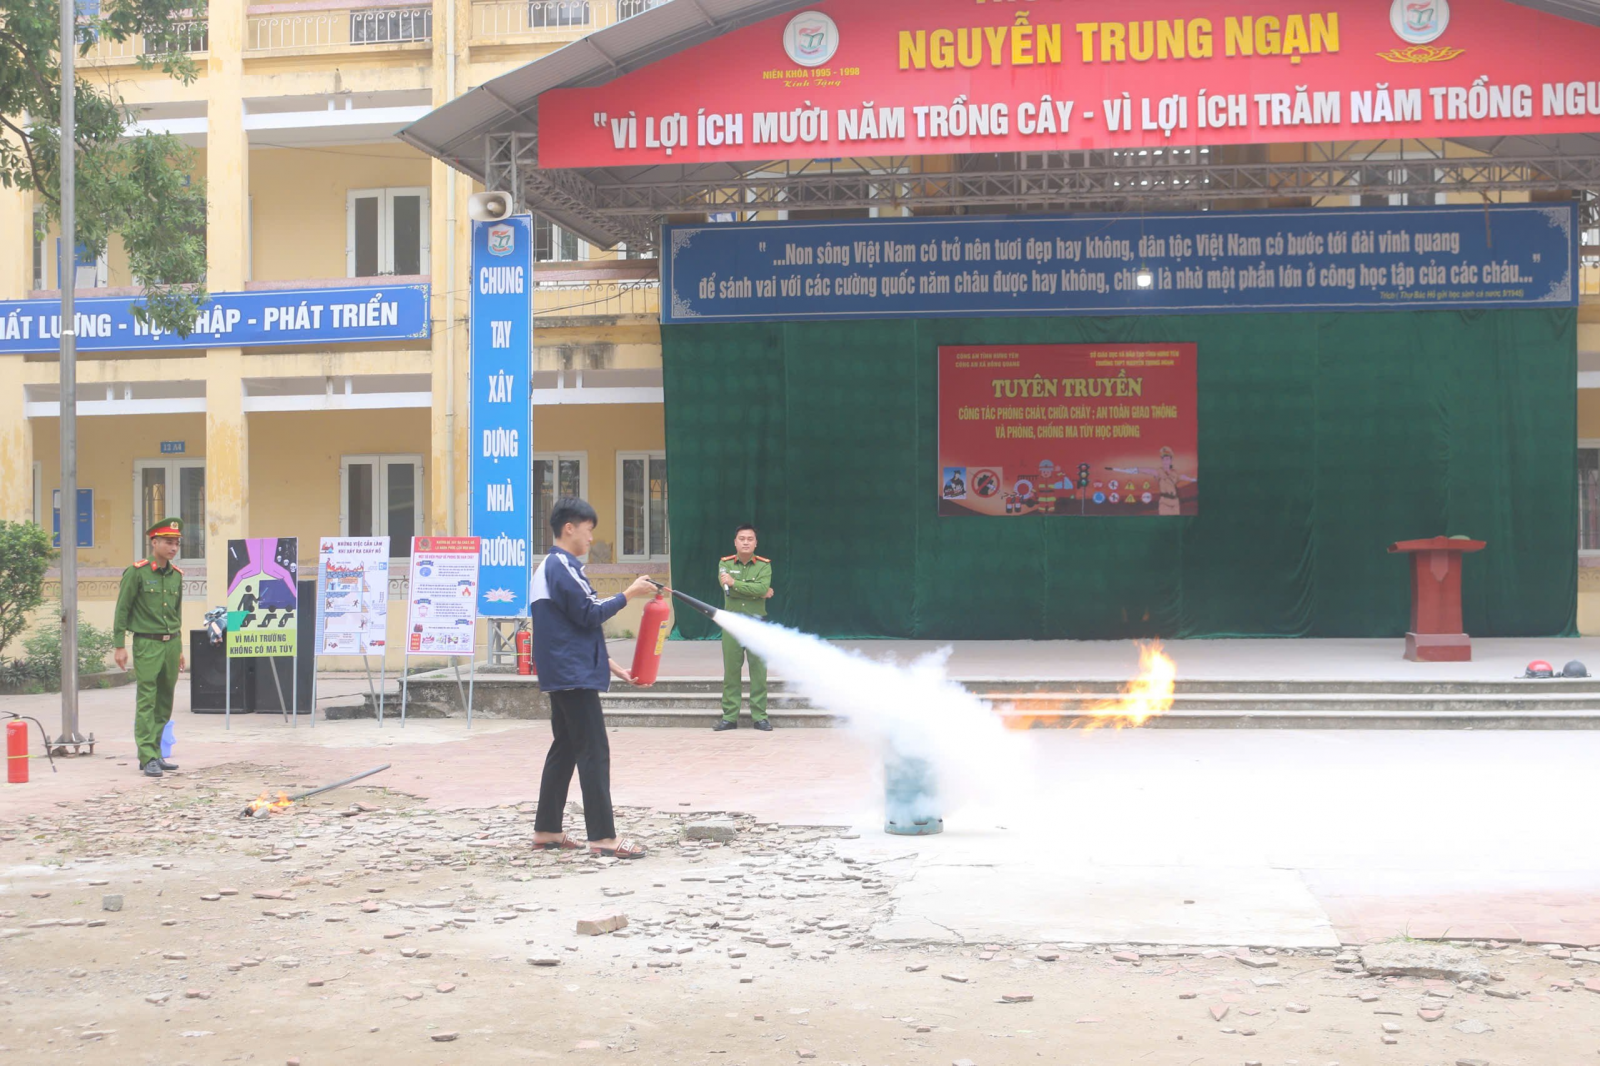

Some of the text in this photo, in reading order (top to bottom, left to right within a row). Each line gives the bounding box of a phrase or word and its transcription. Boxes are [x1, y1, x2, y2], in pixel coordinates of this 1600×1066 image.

[898, 10, 1340, 70] NGUYỄN TRUNG NGẠN
[810, 68, 832, 78] 1995
[839, 67, 860, 76] 1998
[645, 114, 688, 156] LỢI
[697, 108, 744, 146] ÍCH
[753, 100, 829, 144] MƯỜI
[837, 100, 906, 141] NĂM
[913, 94, 1009, 138] TRỒNG
[1017, 94, 1075, 135] CÂY
[1102, 91, 1132, 132] VÌ
[1141, 94, 1188, 138] LỢI
[1198, 88, 1248, 128] ÍCH
[1254, 84, 1341, 126] TRĂM
[1350, 82, 1422, 124] NĂM
[1429, 75, 1533, 120] TRỒNG
[816, 241, 850, 268] sông
[854, 239, 881, 268] Việt
[884, 240, 916, 264] Nam
[920, 238, 938, 263] có
[941, 236, 962, 262] trở
[965, 237, 990, 262] nên
[994, 236, 1022, 260] tươi
[1026, 236, 1052, 265] đẹp
[1056, 236, 1082, 264] hay
[1086, 234, 1134, 263] không,
[1138, 234, 1166, 258] dân
[1169, 234, 1192, 262] tộc
[1196, 233, 1224, 262] Việt
[1228, 233, 1262, 256] Nam
[1265, 232, 1284, 256] có
[1287, 231, 1324, 256] bước
[1327, 230, 1348, 254] tới
[1352, 230, 1375, 254] đài
[1378, 230, 1410, 253] vinh
[1414, 232, 1460, 257] quang
[480, 266, 524, 295] CHUNG
[699, 272, 717, 300] để
[720, 272, 752, 300] sánh
[756, 275, 777, 298] vai
[780, 272, 802, 298] với
[805, 272, 831, 298] các
[834, 270, 878, 300] cường
[881, 268, 916, 298] quốc
[919, 270, 950, 295] năm
[954, 270, 989, 294] châu
[992, 270, 1028, 298] được
[1032, 270, 1058, 296] hay
[1061, 268, 1110, 295] không,
[1158, 266, 1172, 290] là
[1176, 266, 1204, 290] nhờ
[1207, 266, 1236, 294] một
[1239, 260, 1275, 290] phần
[1279, 264, 1302, 288] lớn
[1306, 262, 1317, 286] ở
[1320, 262, 1356, 291] công
[1360, 262, 1387, 291] học
[1390, 262, 1416, 291] tập
[1418, 260, 1447, 286] của
[1450, 260, 1479, 284] các
[264, 298, 326, 333] PHÁT
[330, 292, 398, 328] TRIỂN
[490, 320, 512, 348] TAY
[488, 369, 514, 403] XÂY
[992, 368, 1142, 398] TUYÊN TRUYỀN
[958, 404, 979, 420] CÔNG
[981, 404, 996, 420] TÁC
[1048, 404, 1072, 419] CHỮA
[1073, 404, 1091, 419] CHÁY
[1096, 406, 1108, 419] AN
[1109, 404, 1130, 419] TOÀN
[1132, 405, 1150, 419] GIAO
[1152, 404, 1177, 418] THÔNG
[483, 426, 518, 464] DỰNG
[995, 424, 1006, 438] VÀ
[1037, 422, 1064, 438] CHỐNG
[1065, 426, 1078, 438] MA
[1095, 425, 1112, 440] HỌC
[487, 478, 514, 512] NHÀ
[230, 646, 253, 654] KHÔNG
[255, 645, 264, 654] CÓ
[279, 645, 293, 653] TÚY
[244, 633, 257, 643] MÁI
[260, 633, 287, 643] TRƯỜNG
